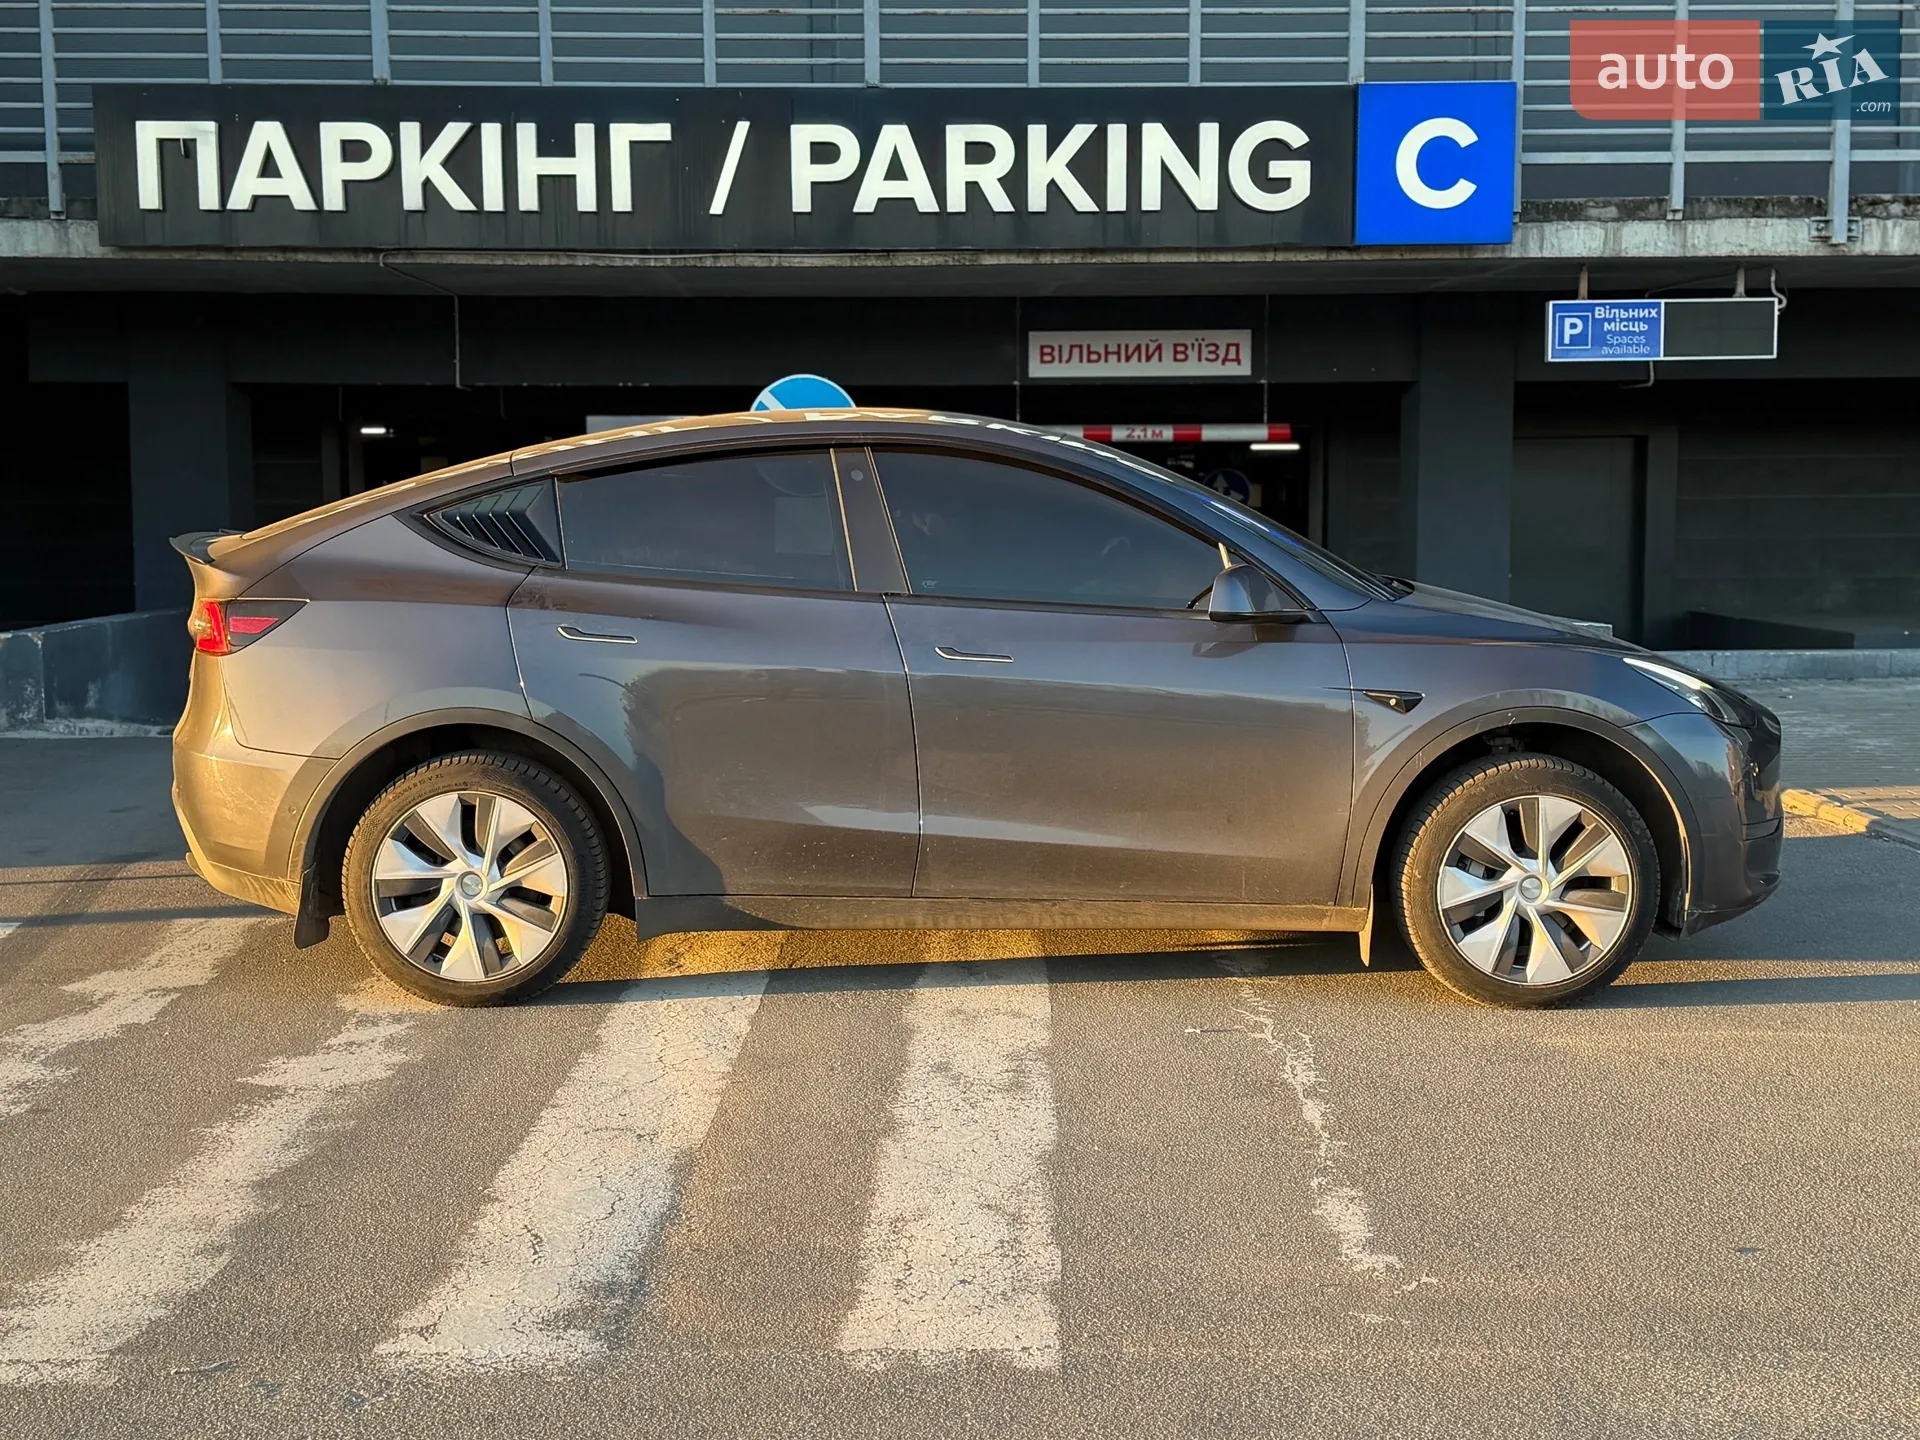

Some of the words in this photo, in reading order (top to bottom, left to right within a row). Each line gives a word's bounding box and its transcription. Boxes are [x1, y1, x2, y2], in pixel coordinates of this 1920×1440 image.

[135, 120, 672, 212] ПАРКІНГ
[709, 120, 750, 215] /
[790, 120, 1311, 213] PARKING
[1395, 117, 1479, 210] C
[1594, 306, 1658, 319] Вільних
[1563, 317, 1584, 345] P
[1603, 319, 1649, 333] місць
[1606, 334, 1647, 345] Spaces
[1039, 339, 1163, 364] ВІЛЬНИЙ
[1172, 337, 1242, 366] В'ЇЗД
[1601, 345, 1650, 355] available
